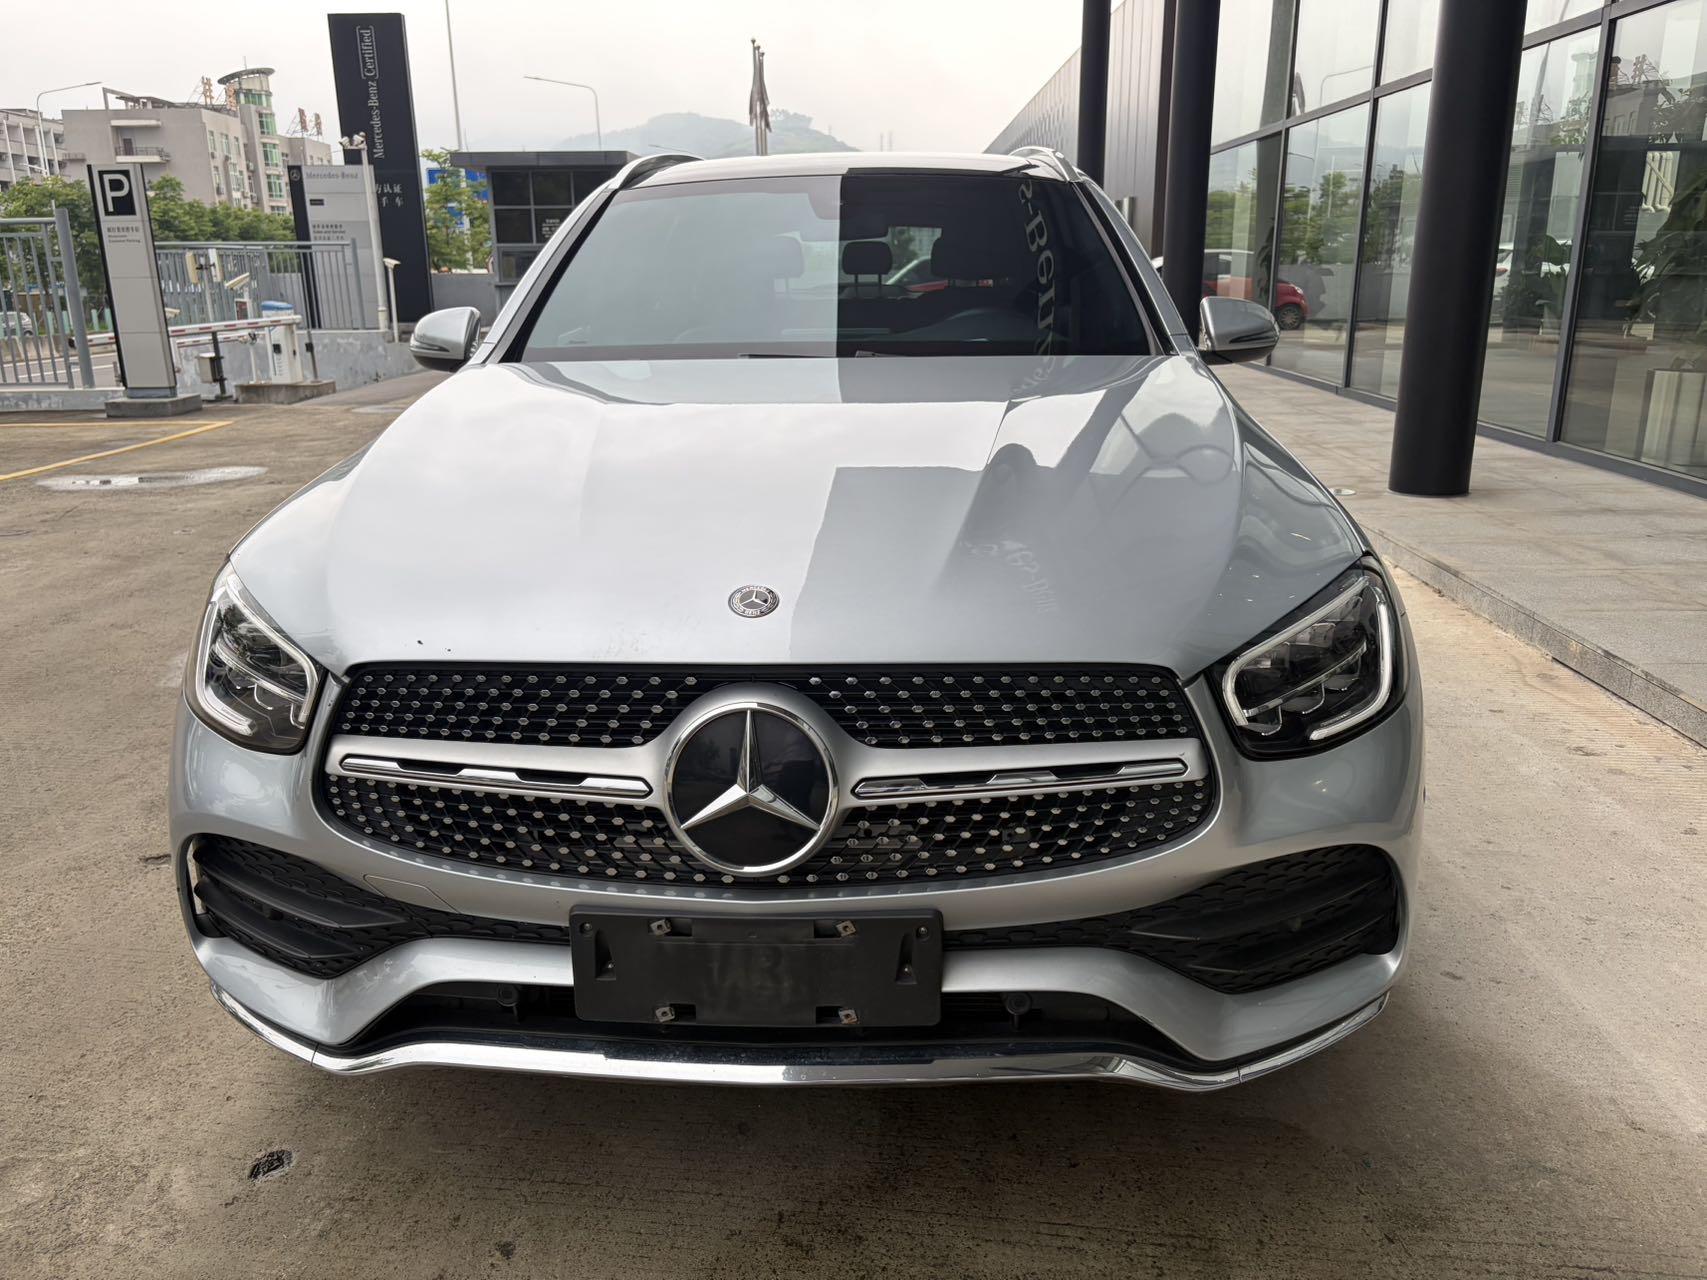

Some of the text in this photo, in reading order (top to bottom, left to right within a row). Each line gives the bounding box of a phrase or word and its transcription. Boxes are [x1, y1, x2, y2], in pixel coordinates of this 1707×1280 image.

[360, 29, 385, 160] Mercedes-Benz Certified
[102, 173, 130, 212] P
